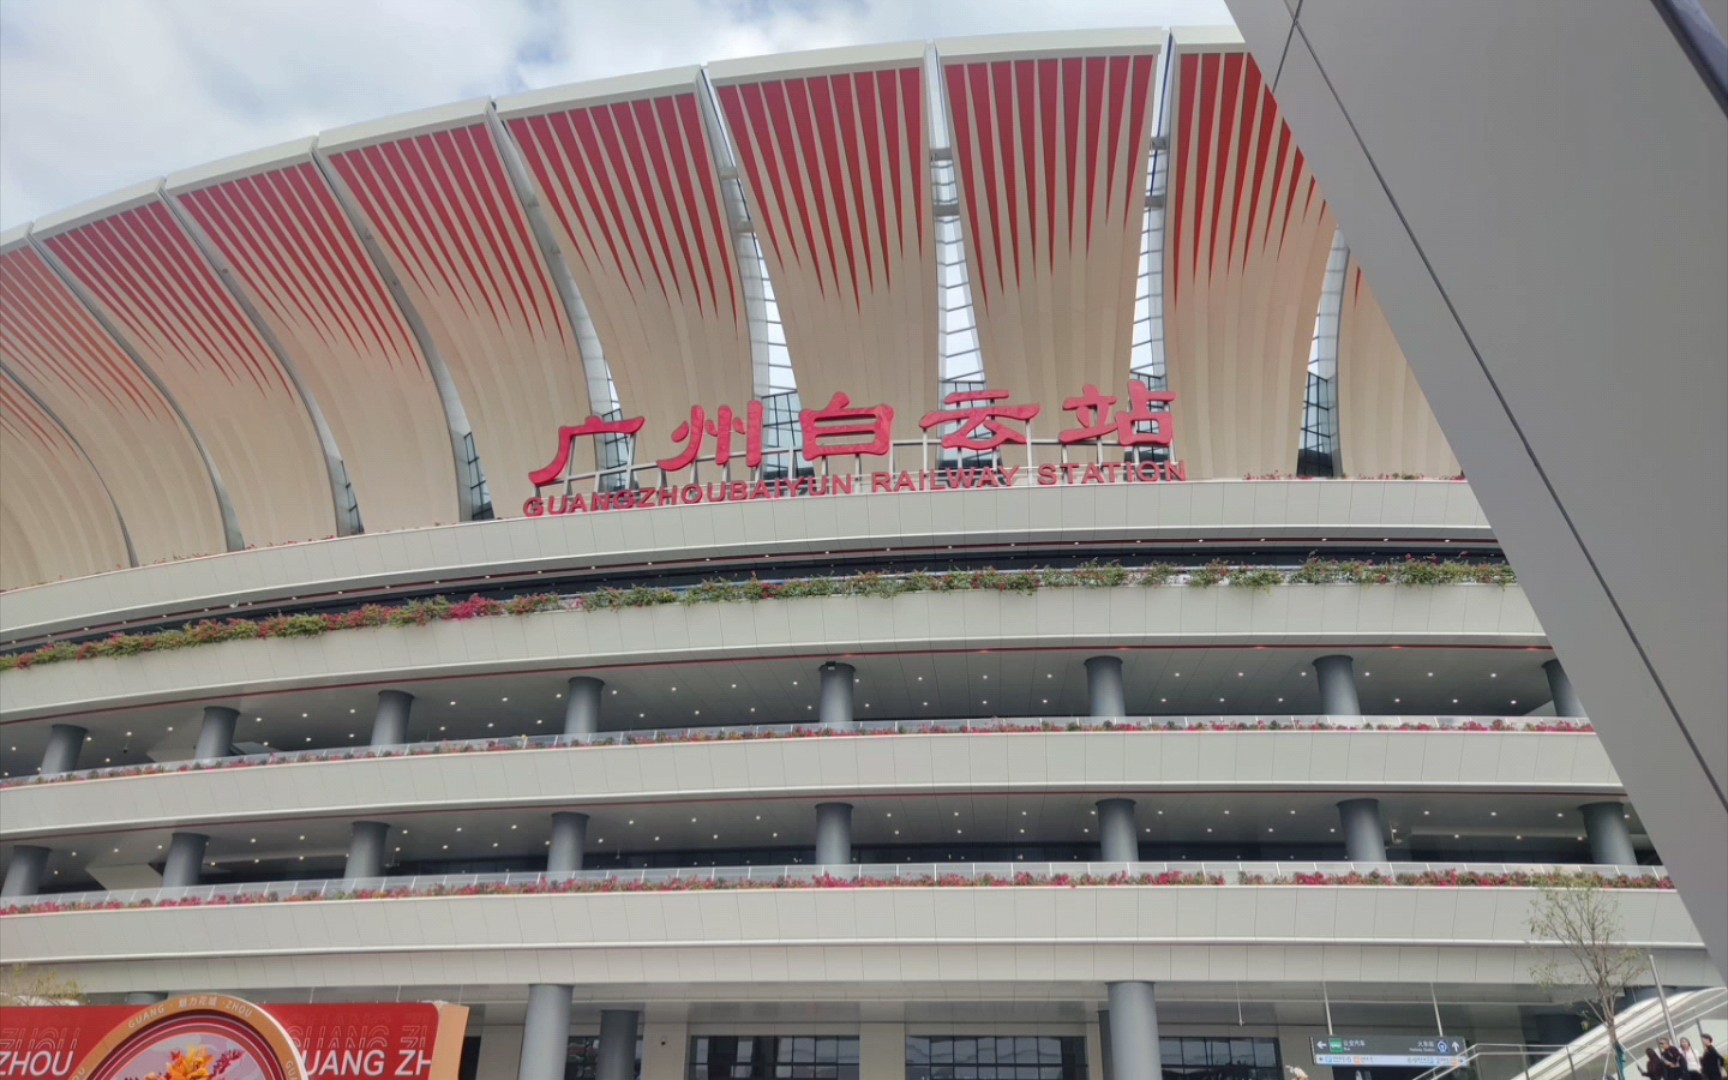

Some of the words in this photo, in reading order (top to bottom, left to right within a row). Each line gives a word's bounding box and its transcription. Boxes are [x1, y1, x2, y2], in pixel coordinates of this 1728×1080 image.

[528, 380, 1177, 486] 广州白云站
[523, 474, 853, 517] GUANGZHOUBAIYUN
[871, 464, 1021, 493] RAILWAY
[1037, 459, 1186, 485] STATION
[128, 1003, 165, 1028] GUANG
[223, 1000, 253, 1018] ZHOU
[300, 1049, 385, 1076] UANG
